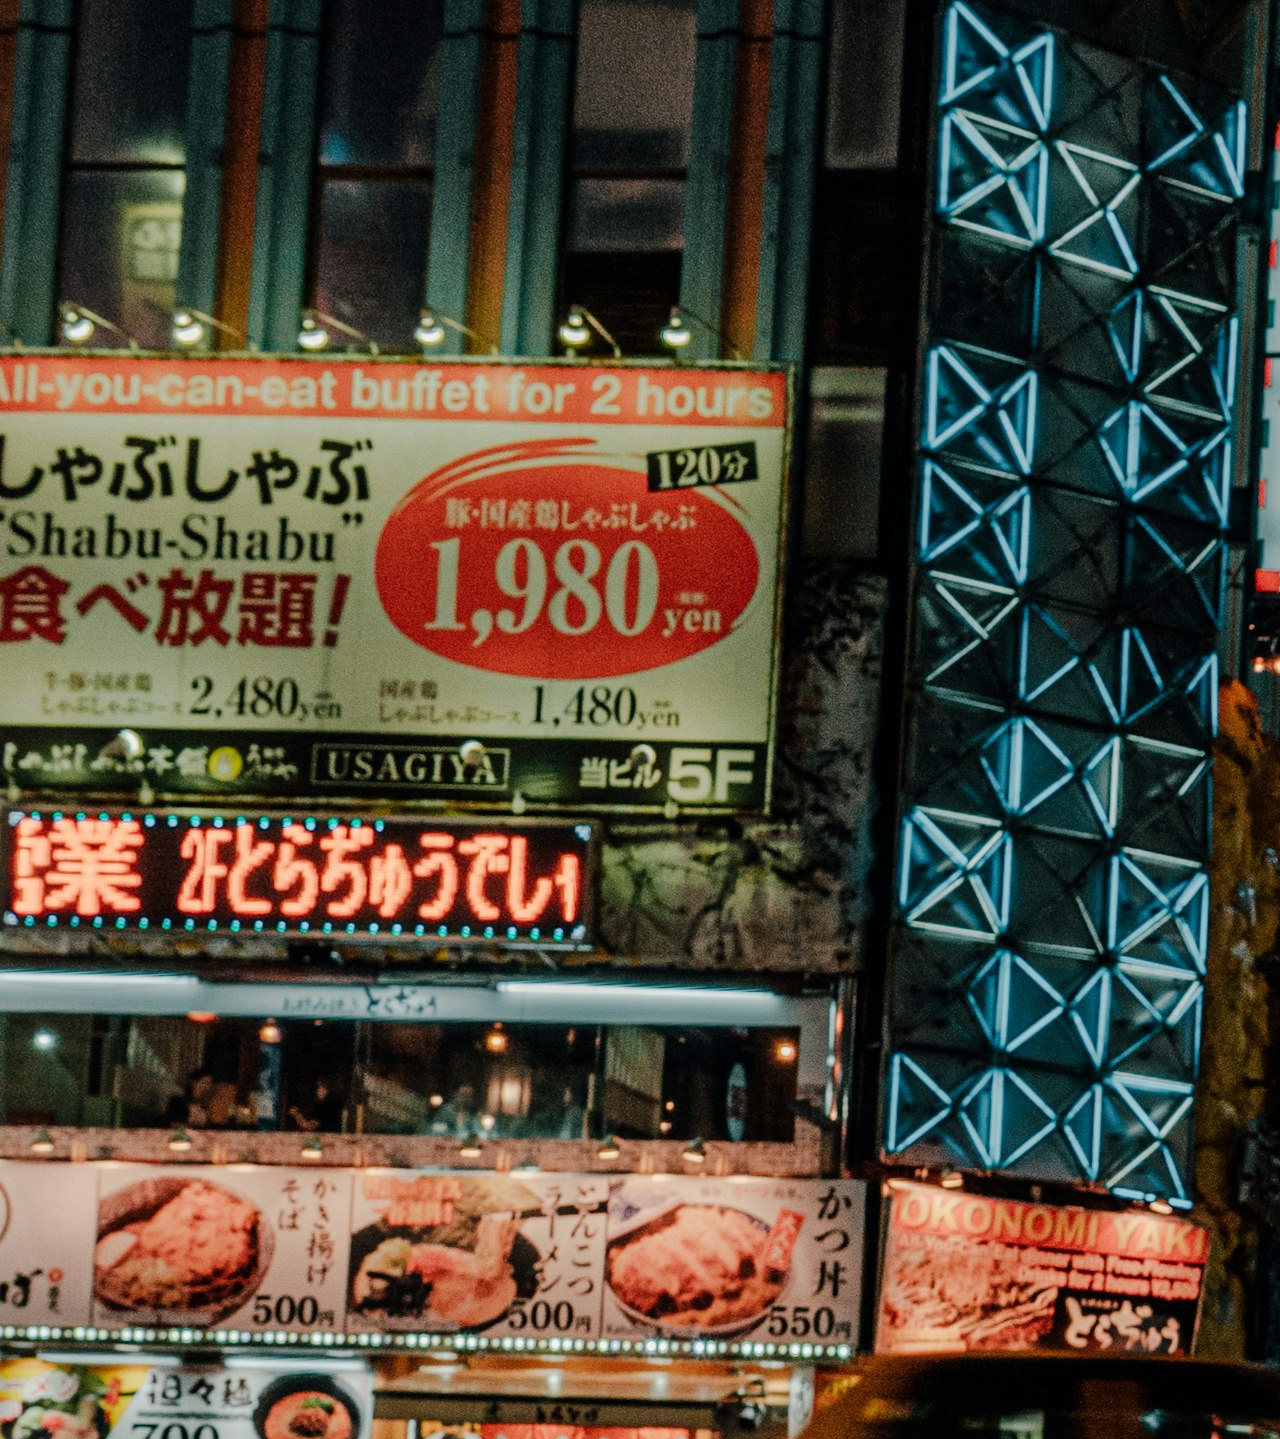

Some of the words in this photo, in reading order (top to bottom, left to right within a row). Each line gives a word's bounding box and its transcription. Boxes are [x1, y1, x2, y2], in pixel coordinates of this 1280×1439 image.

[351, 368, 490, 413] buffet
[507, 368, 575, 414] for
[590, 371, 622, 417] 2
[636, 371, 774, 419] hours
[0, 433, 374, 505] しゃぶしゃぶ
[658, 446, 749, 490] 120分
[425, 536, 661, 649] 1,980
[664, 606, 722, 637] yen
[189, 674, 299, 718] 2,480
[300, 699, 342, 722] yen
[532, 684, 637, 728] 1,480
[637, 710, 680, 731] yen
[667, 747, 755, 803] 5F
[278, 1179, 302, 1232] そば
[306, 1176, 337, 1286] かき揚げ
[899, 1193, 1099, 1249] OKONOMI
[1111, 1214, 1207, 1259] YAKI
[537, 1185, 561, 1294] ラーメン
[567, 1184, 599, 1297] とんこつ
[815, 1186, 853, 1298] かつ丼
